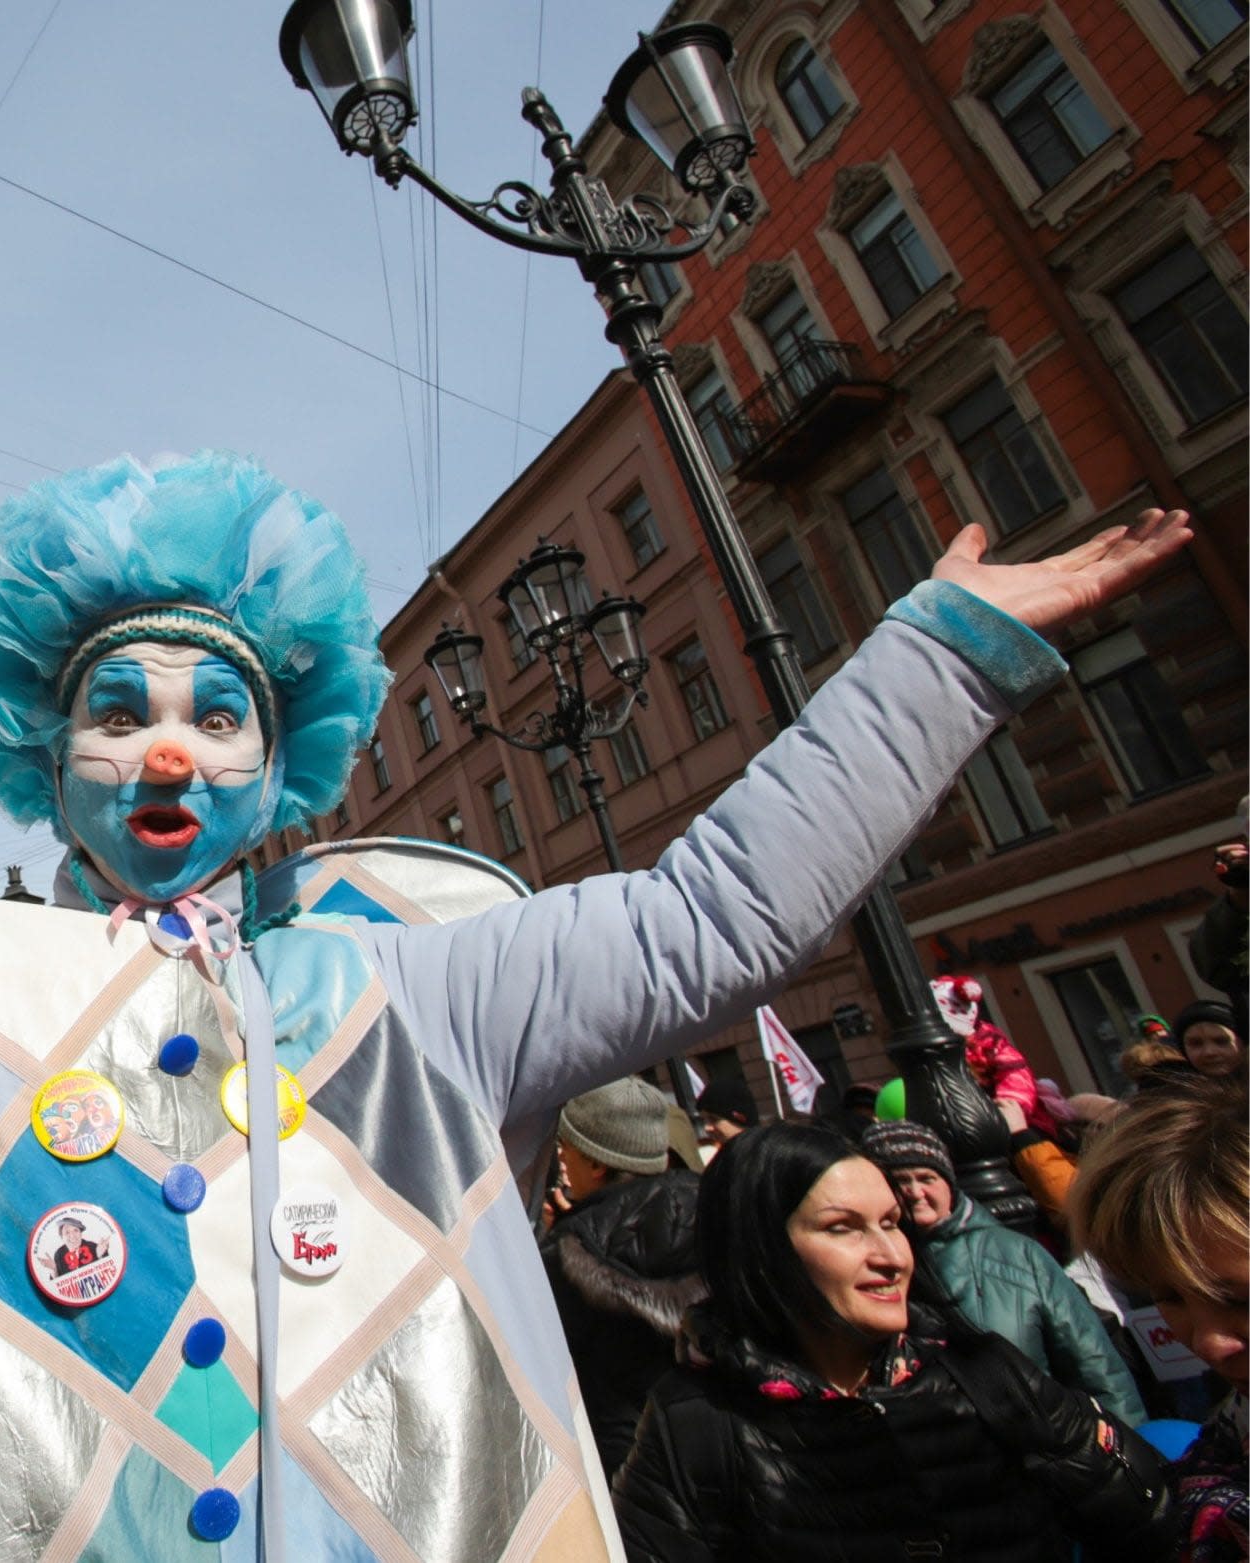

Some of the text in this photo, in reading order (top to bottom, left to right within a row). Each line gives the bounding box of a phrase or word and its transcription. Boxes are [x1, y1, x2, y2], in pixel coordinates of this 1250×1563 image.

[283, 1200, 338, 1221] САТИРИЧЕСКИЙ
[64, 1246, 94, 1270] 93
[59, 1267, 117, 1299] МИМИГРАНТЫ
